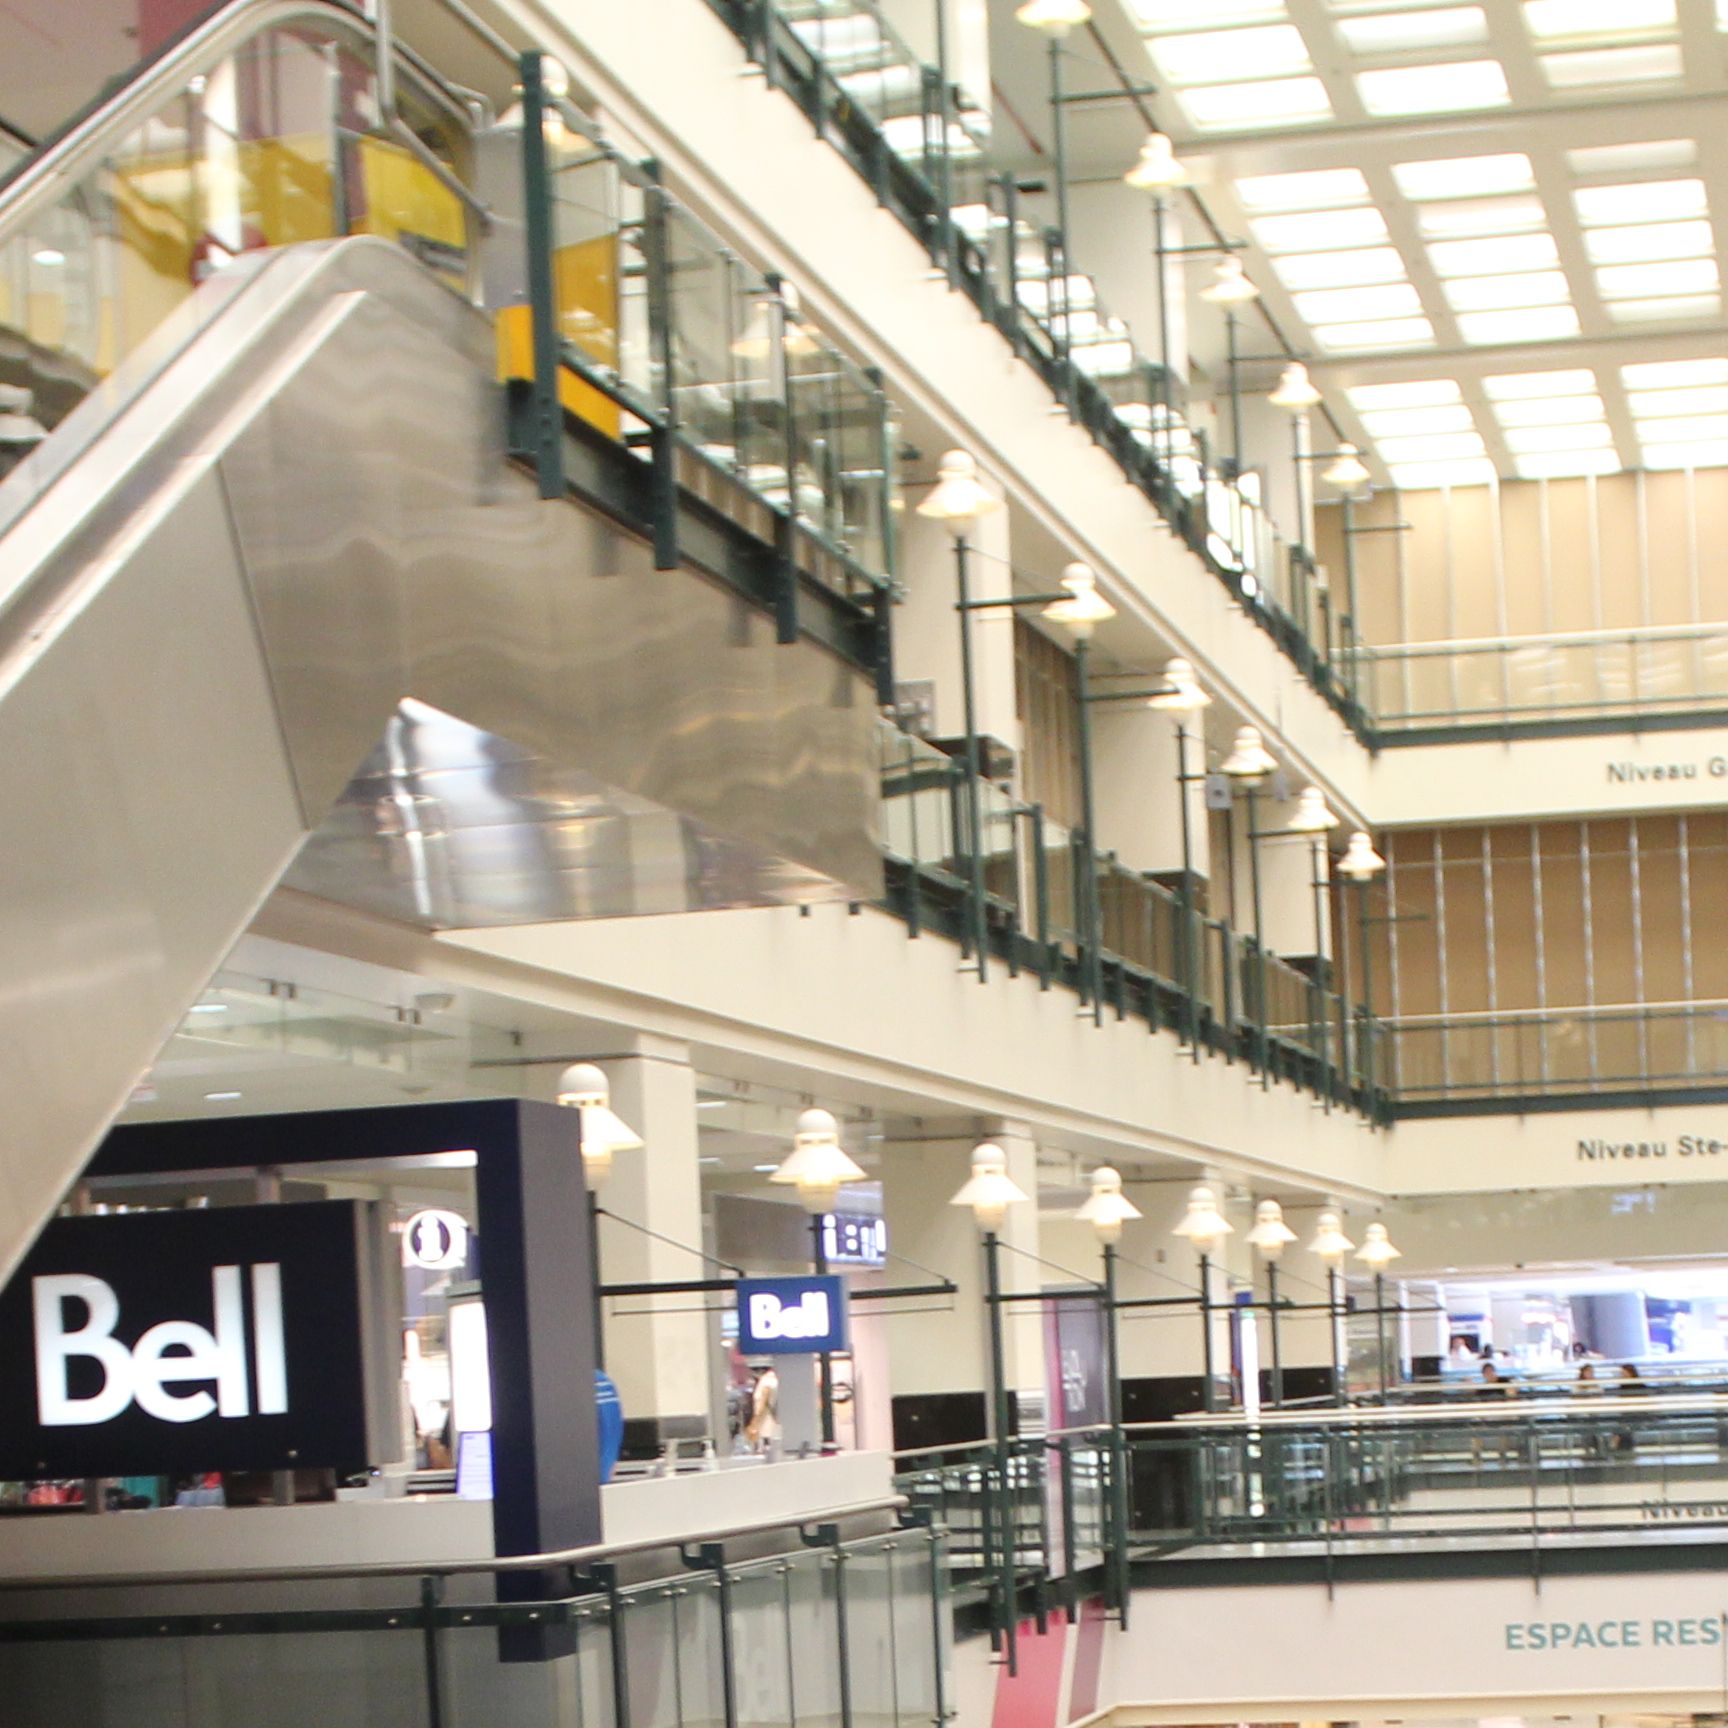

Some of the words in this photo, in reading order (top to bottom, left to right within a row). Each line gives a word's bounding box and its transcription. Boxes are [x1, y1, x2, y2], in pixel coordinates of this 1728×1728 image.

[1607, 762, 1697, 783] Niveau
[1576, 1138, 1667, 1161] Niveau
[749, 1291, 829, 1339] Bell
[31, 1262, 288, 1426] Bell
[1504, 1621, 1642, 1650] ESPACE
